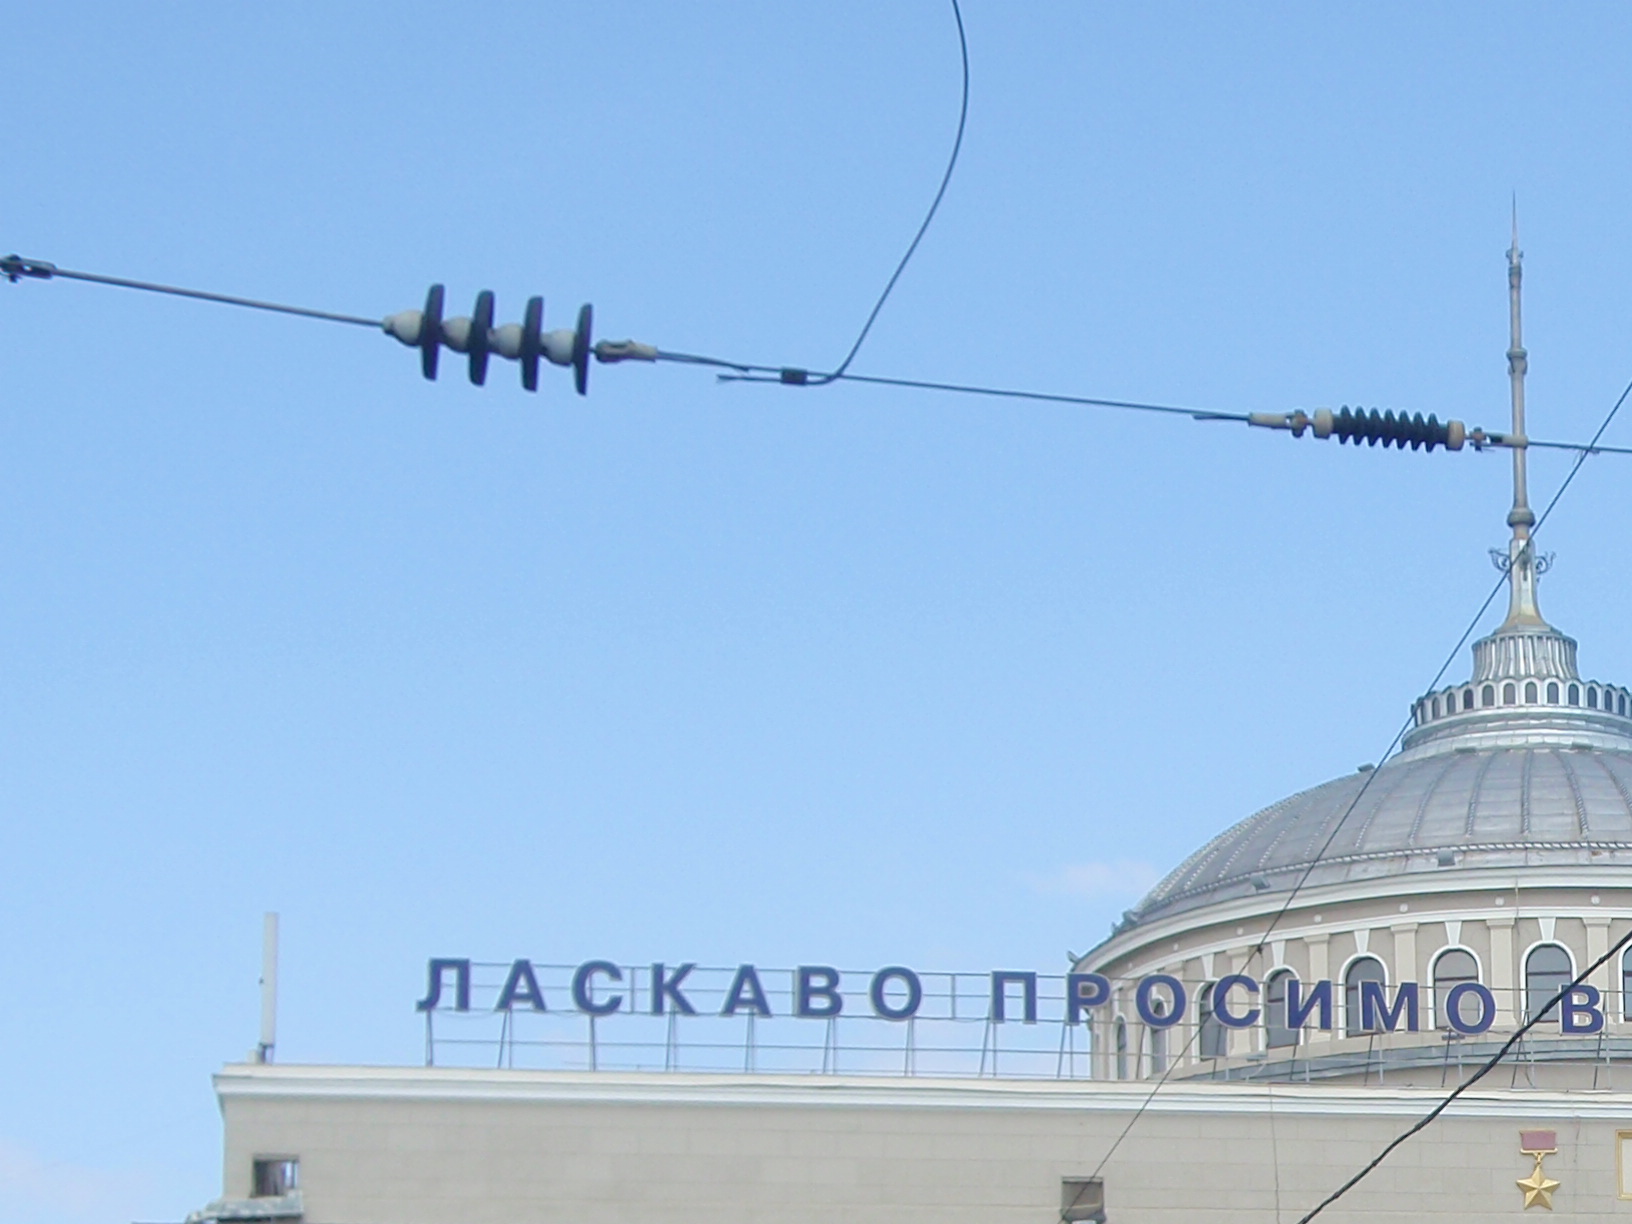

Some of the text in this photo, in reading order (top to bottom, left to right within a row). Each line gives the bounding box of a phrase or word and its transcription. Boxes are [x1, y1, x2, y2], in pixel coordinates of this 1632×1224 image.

[417, 957, 922, 1020] ЛАСКАВО
[990, 971, 1496, 1037] ПРОСИМО
[1560, 983, 1604, 1035] В
